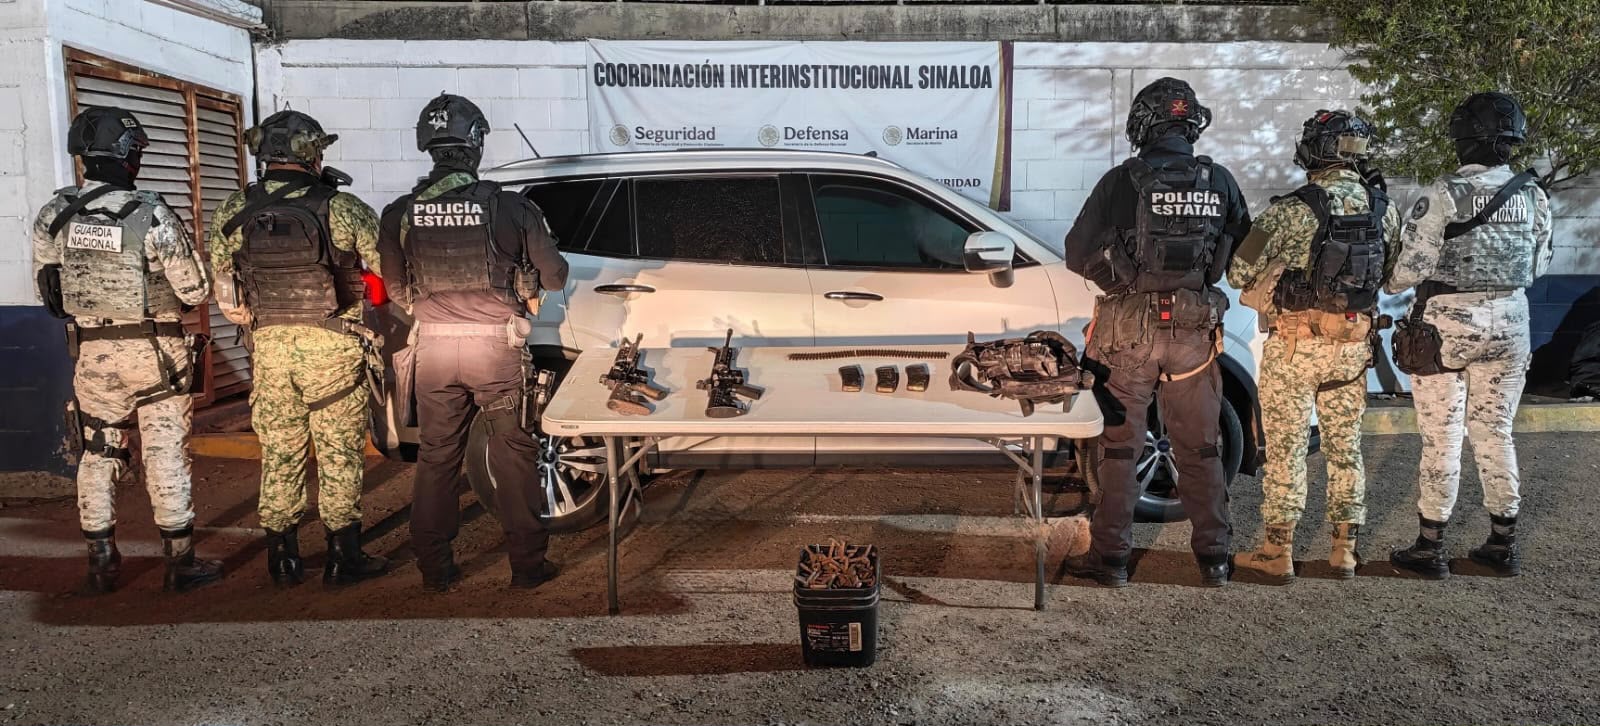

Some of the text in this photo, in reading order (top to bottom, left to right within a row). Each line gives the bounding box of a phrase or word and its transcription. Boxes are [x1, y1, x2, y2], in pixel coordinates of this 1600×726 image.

[594, 60, 993, 89] COORDINACIÓN INTERINSTITUCIONAL SINALOA
[635, 126, 716, 143] Seguridad
[784, 126, 849, 140] Defensa
[906, 127, 958, 140] Marina
[936, 178, 981, 188] RIDAD
[1151, 190, 1221, 204] POLICÍA
[1475, 196, 1525, 209] GDIA
[413, 201, 484, 214] POLICÍA
[1151, 203, 1222, 217] ESTATAL
[413, 215, 481, 227] ESTATAL
[1475, 208, 1527, 222] IONAL
[74, 224, 113, 238] GUARDIA
[71, 236, 117, 250] NACIONAL
